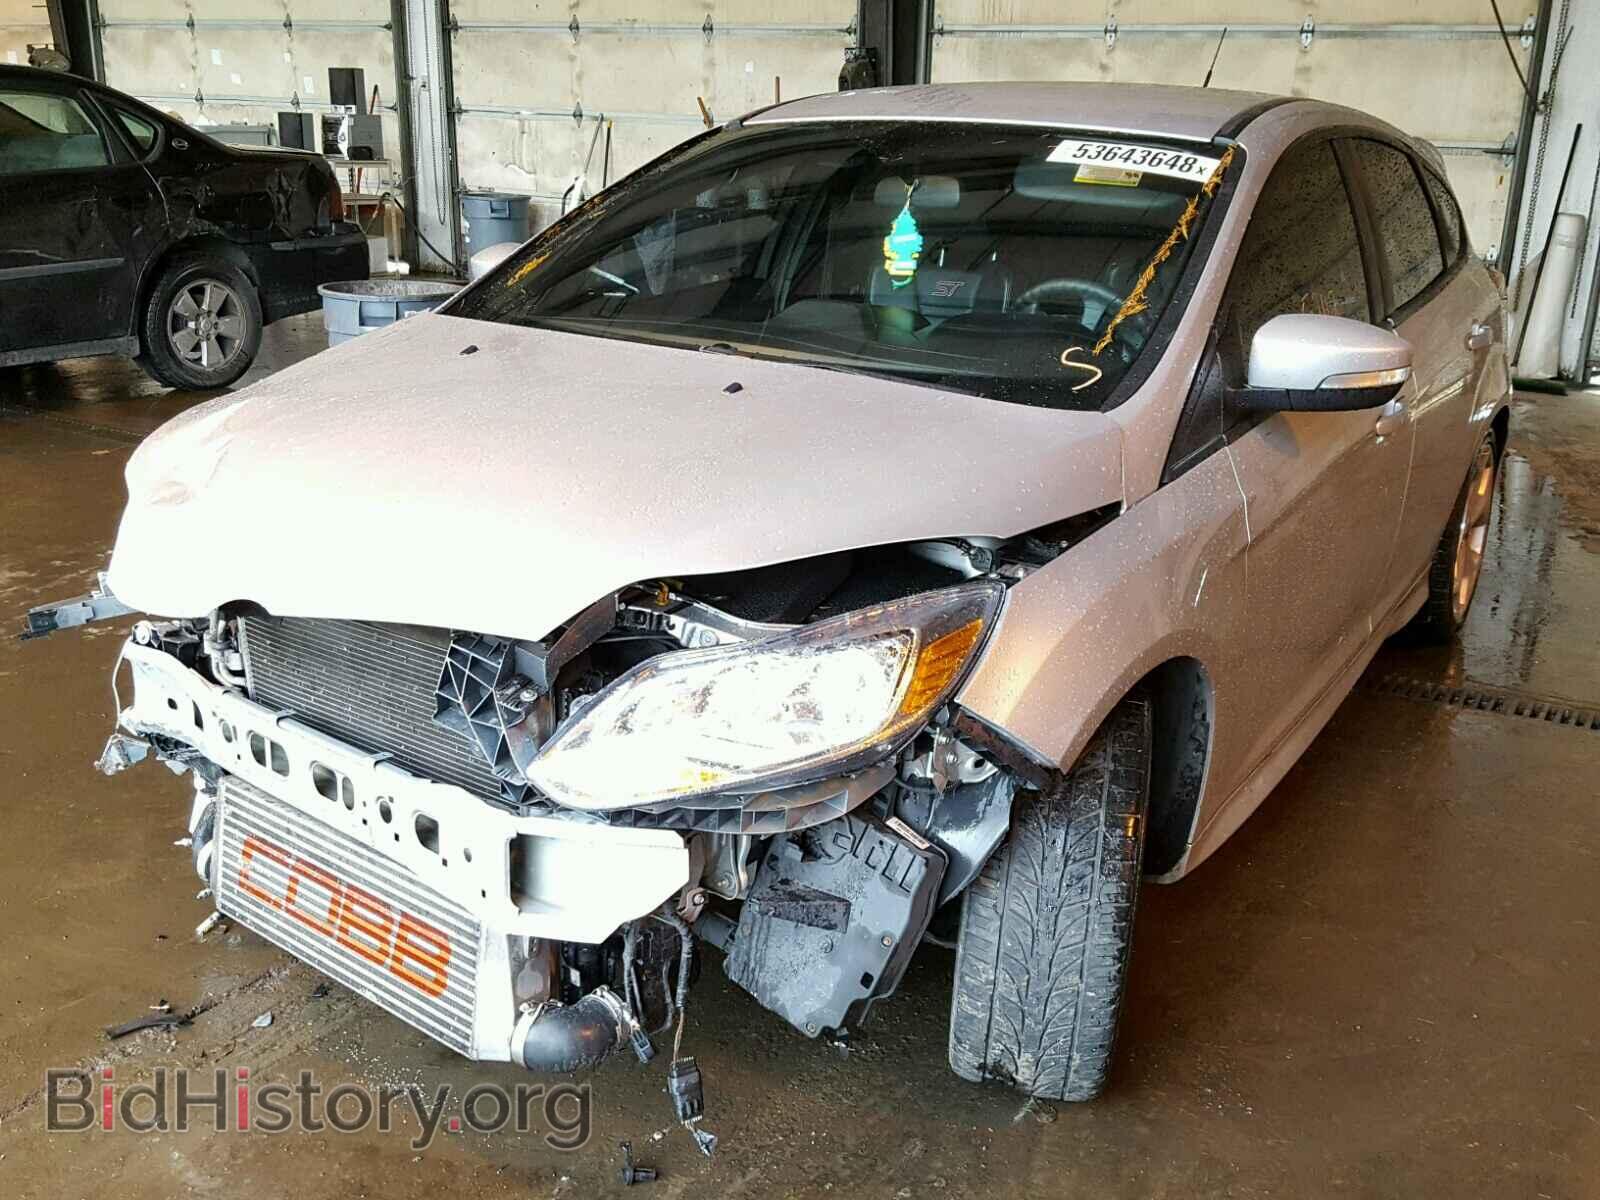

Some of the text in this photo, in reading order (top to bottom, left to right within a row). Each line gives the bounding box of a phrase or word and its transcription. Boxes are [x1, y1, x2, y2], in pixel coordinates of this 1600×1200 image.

[1072, 143, 1198, 173] 53643648
[928, 280, 966, 297] ST
[238, 833, 453, 998] COBB
